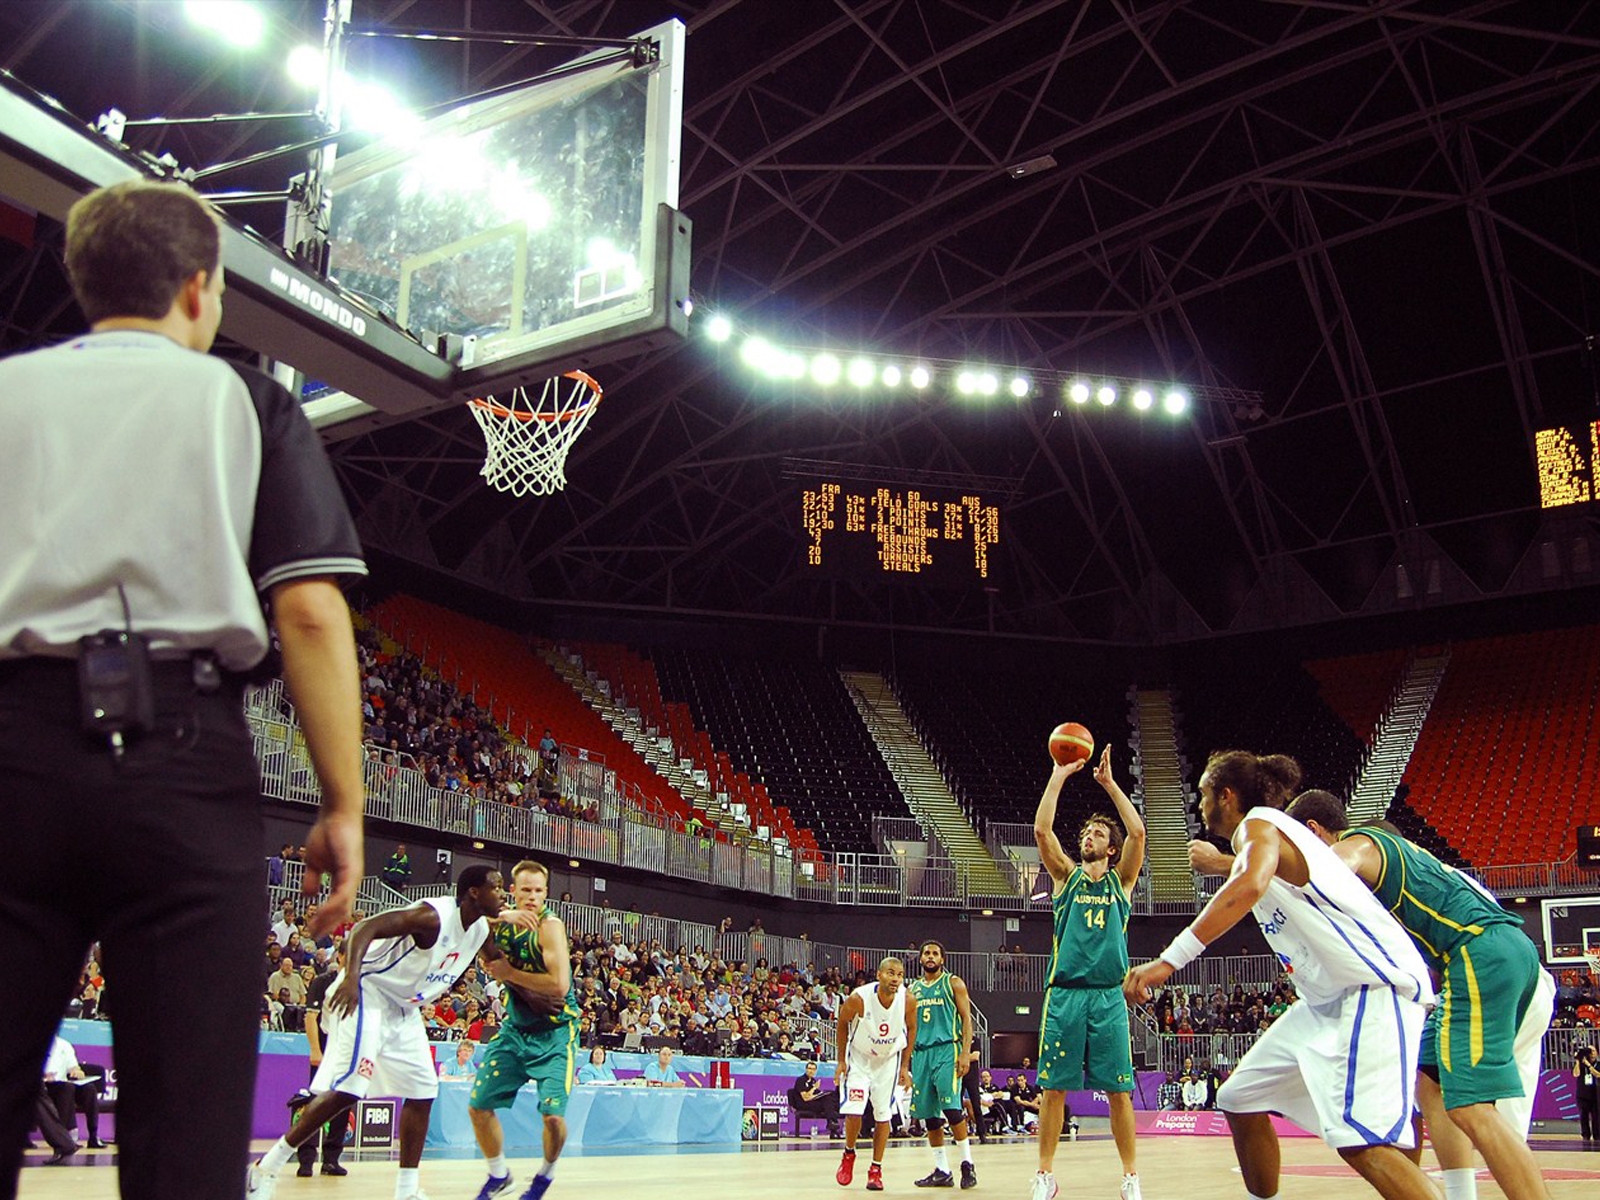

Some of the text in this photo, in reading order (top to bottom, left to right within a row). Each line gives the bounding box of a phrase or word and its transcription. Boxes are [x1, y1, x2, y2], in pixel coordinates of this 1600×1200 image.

[289, 278, 366, 336] MONDO
[822, 484, 840, 494] FRA
[877, 488, 890, 498] 66
[908, 490, 920, 501] 60
[803, 490, 834, 502] 23/53
[871, 496, 901, 508] FIELD
[908, 500, 938, 511] GOALS
[968, 506, 998, 516] 22/56
[803, 500, 834, 512] 22/43
[890, 507, 926, 518] POINTS
[962, 496, 980, 506] AUS
[803, 509, 828, 520] 1/10
[890, 516, 926, 527] POINTS
[803, 518, 834, 530] 19/30
[871, 523, 895, 534] FREE
[902, 526, 938, 538] THROWS
[808, 527, 987, 551] 43 REBOUNDS 25
[808, 545, 987, 569] 20 TURNOVERS 18
[815, 537, 987, 560] 7 ASSISTS 14
[809, 555, 821, 565] 10
[883, 560, 920, 573] STEALS
[1073, 895, 1116, 905] AUSTRALA
[1084, 909, 1105, 929] 14
[923, 1007, 931, 1022] 5
[879, 1023, 889, 1037] 9
[763, 1090, 789, 1104] London
[366, 1108, 390, 1125] FIBA
[763, 1111, 778, 1124] FIBA
[1156, 1119, 1196, 1130] Prepares
[1166, 1113, 1197, 1121] London
